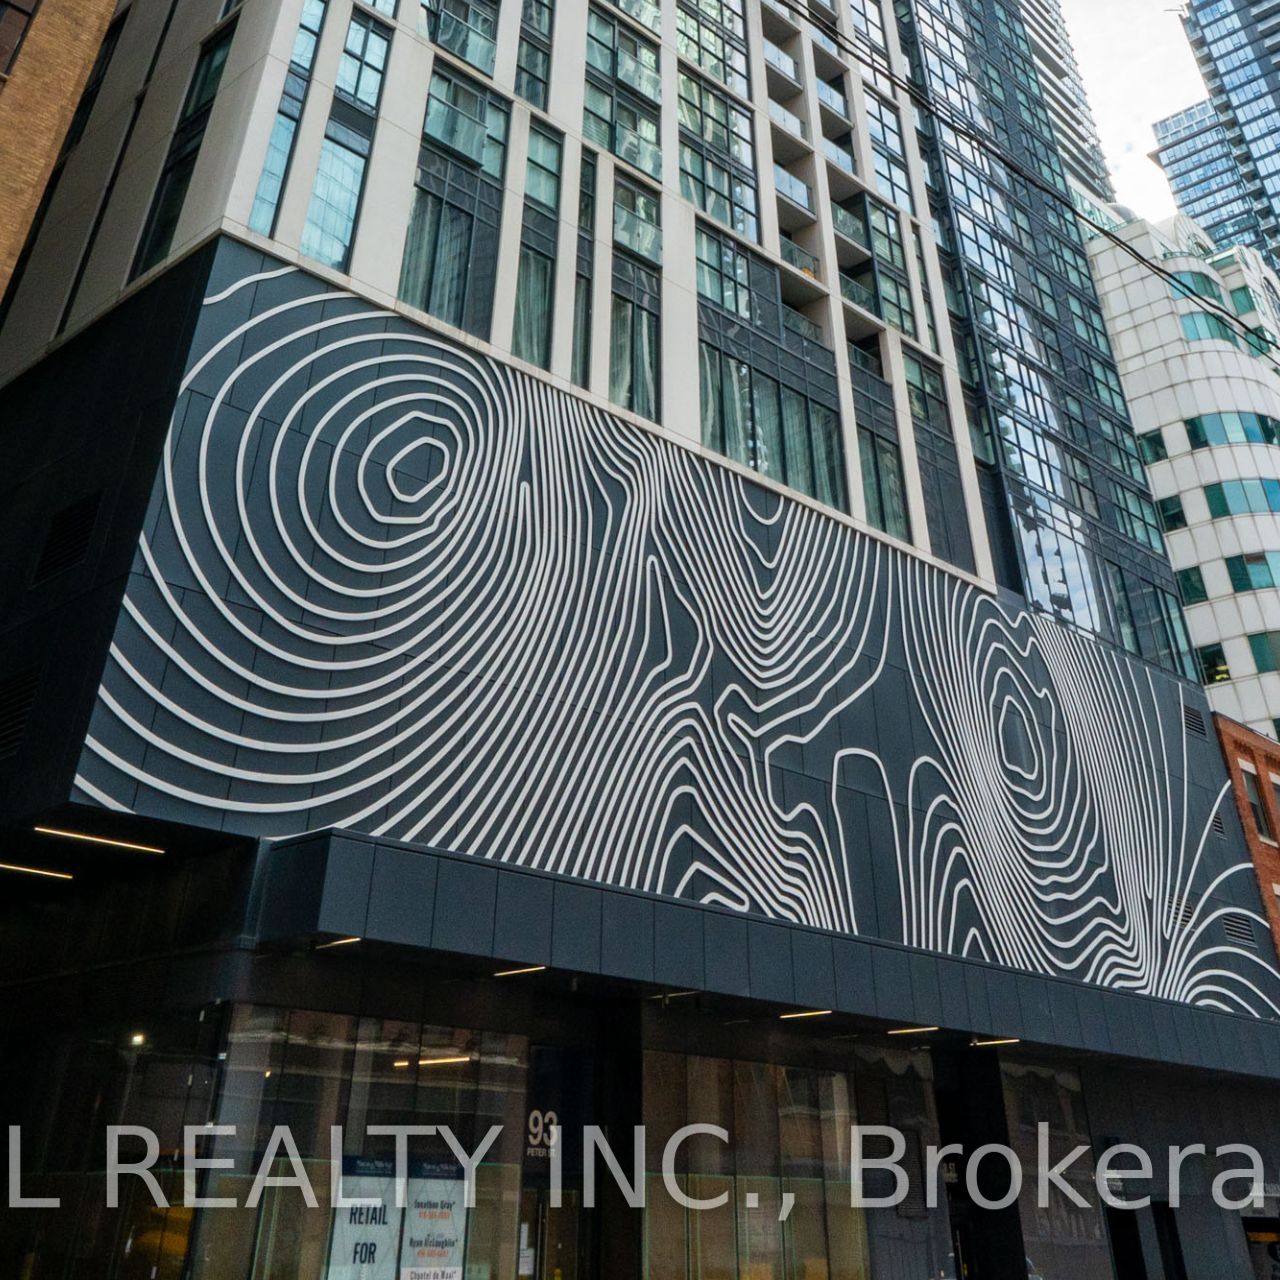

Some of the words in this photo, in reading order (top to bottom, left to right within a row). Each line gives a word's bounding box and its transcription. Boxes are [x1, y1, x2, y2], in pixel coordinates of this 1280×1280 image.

[527, 1109, 558, 1147] 93
[349, 1205, 389, 1225] RETAIL
[352, 1242, 377, 1264] FOR
